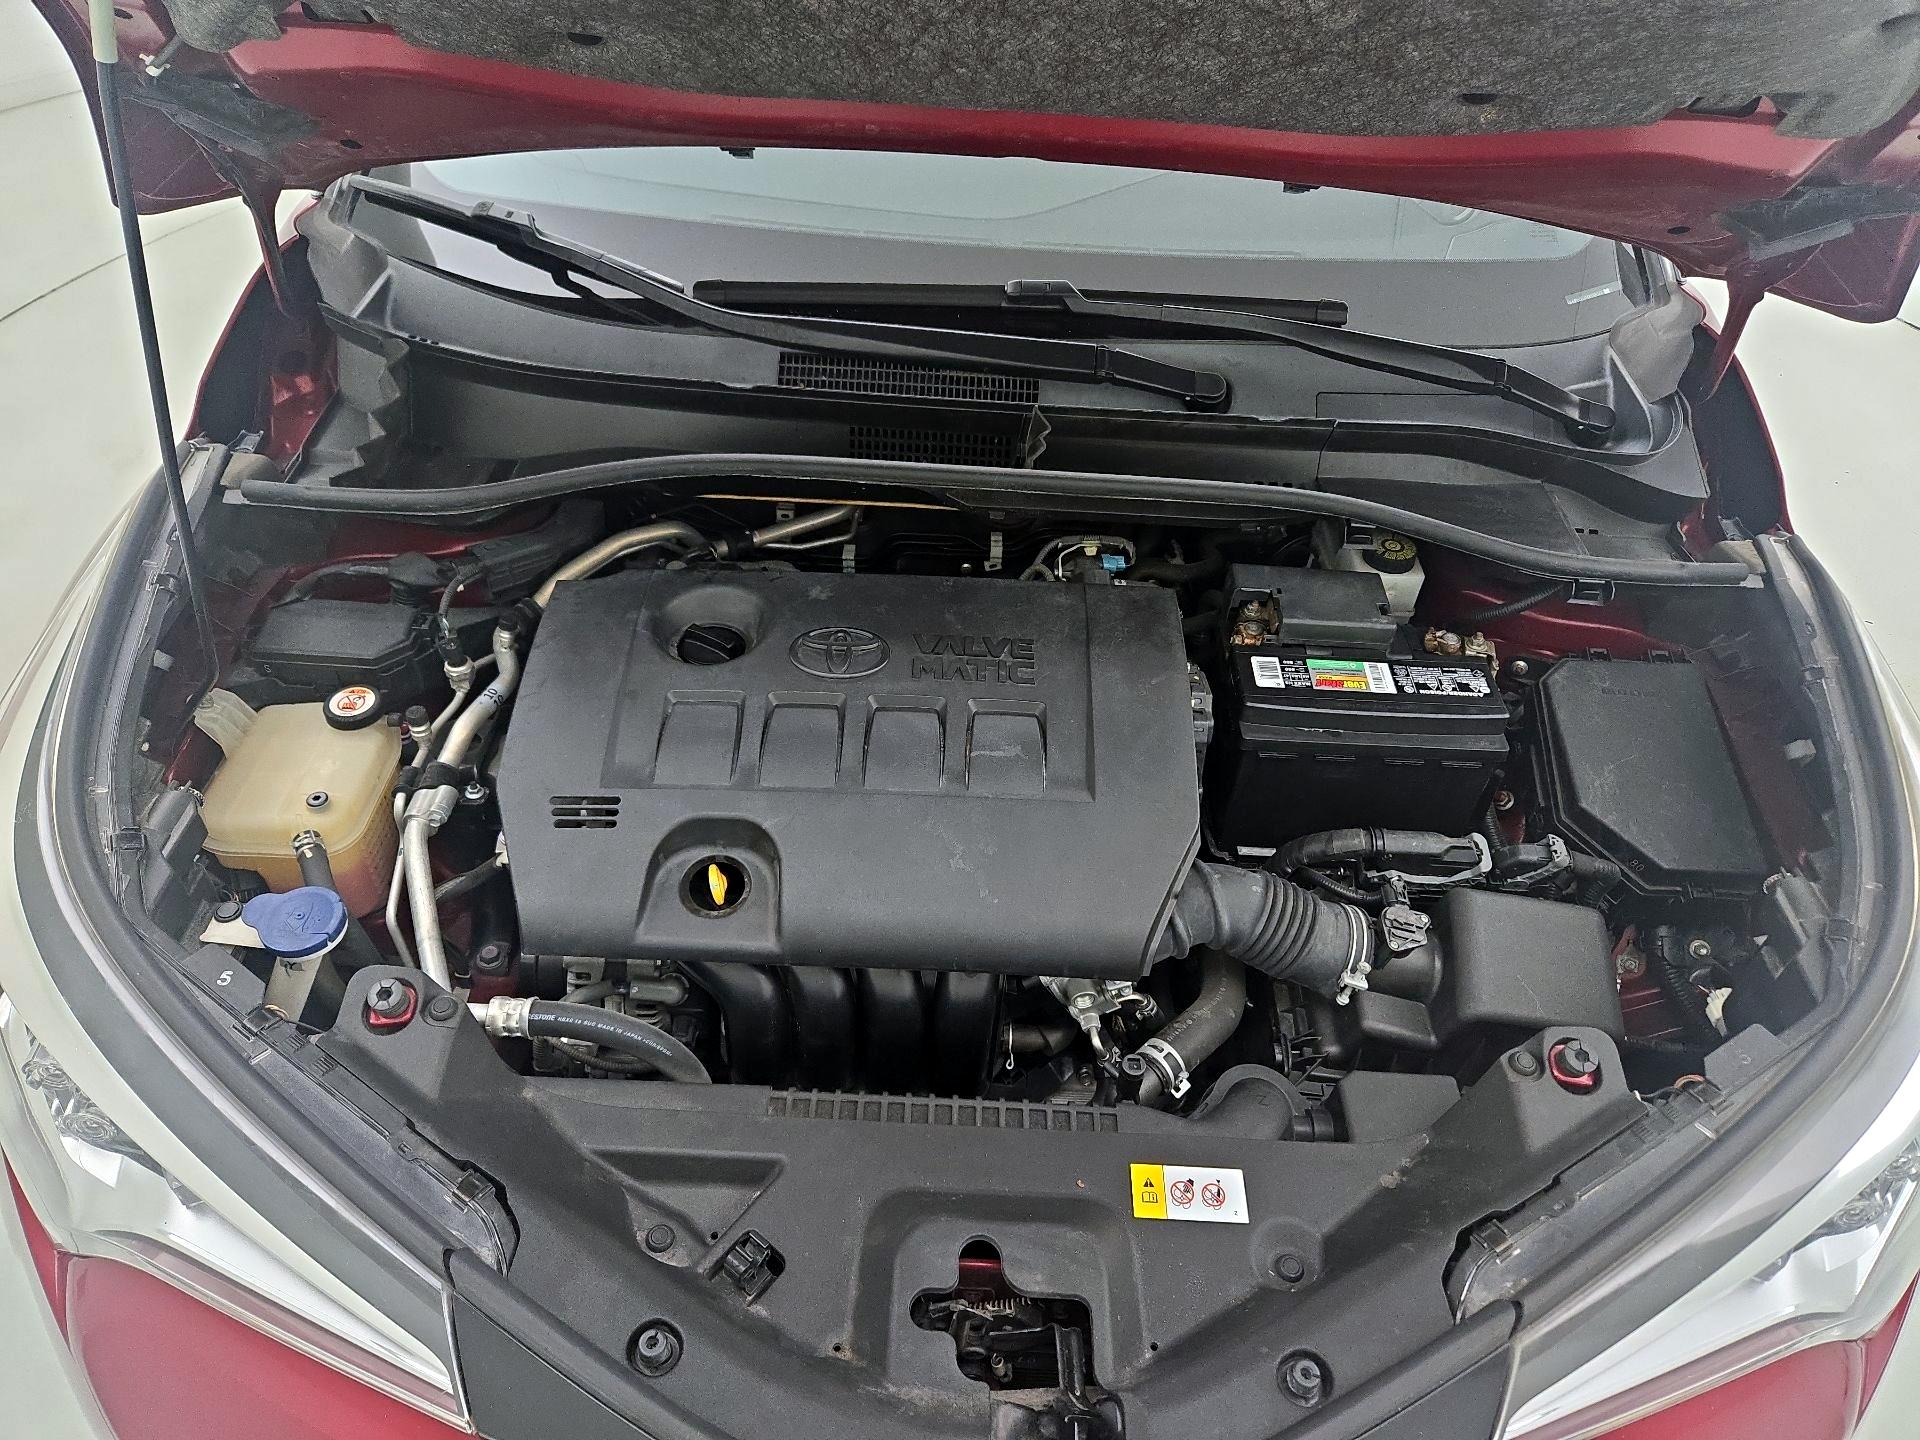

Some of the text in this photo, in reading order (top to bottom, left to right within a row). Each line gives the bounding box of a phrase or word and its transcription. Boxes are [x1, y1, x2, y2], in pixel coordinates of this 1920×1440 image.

[912, 633, 1036, 660] VALVE
[911, 657, 1037, 685] MATIC
[1315, 678, 1368, 691] EverStart
[483, 688, 498, 701] 10
[216, 970, 234, 986] 5
[597, 1022, 615, 1032] MADE
[623, 1030, 643, 1041] JAPAN
